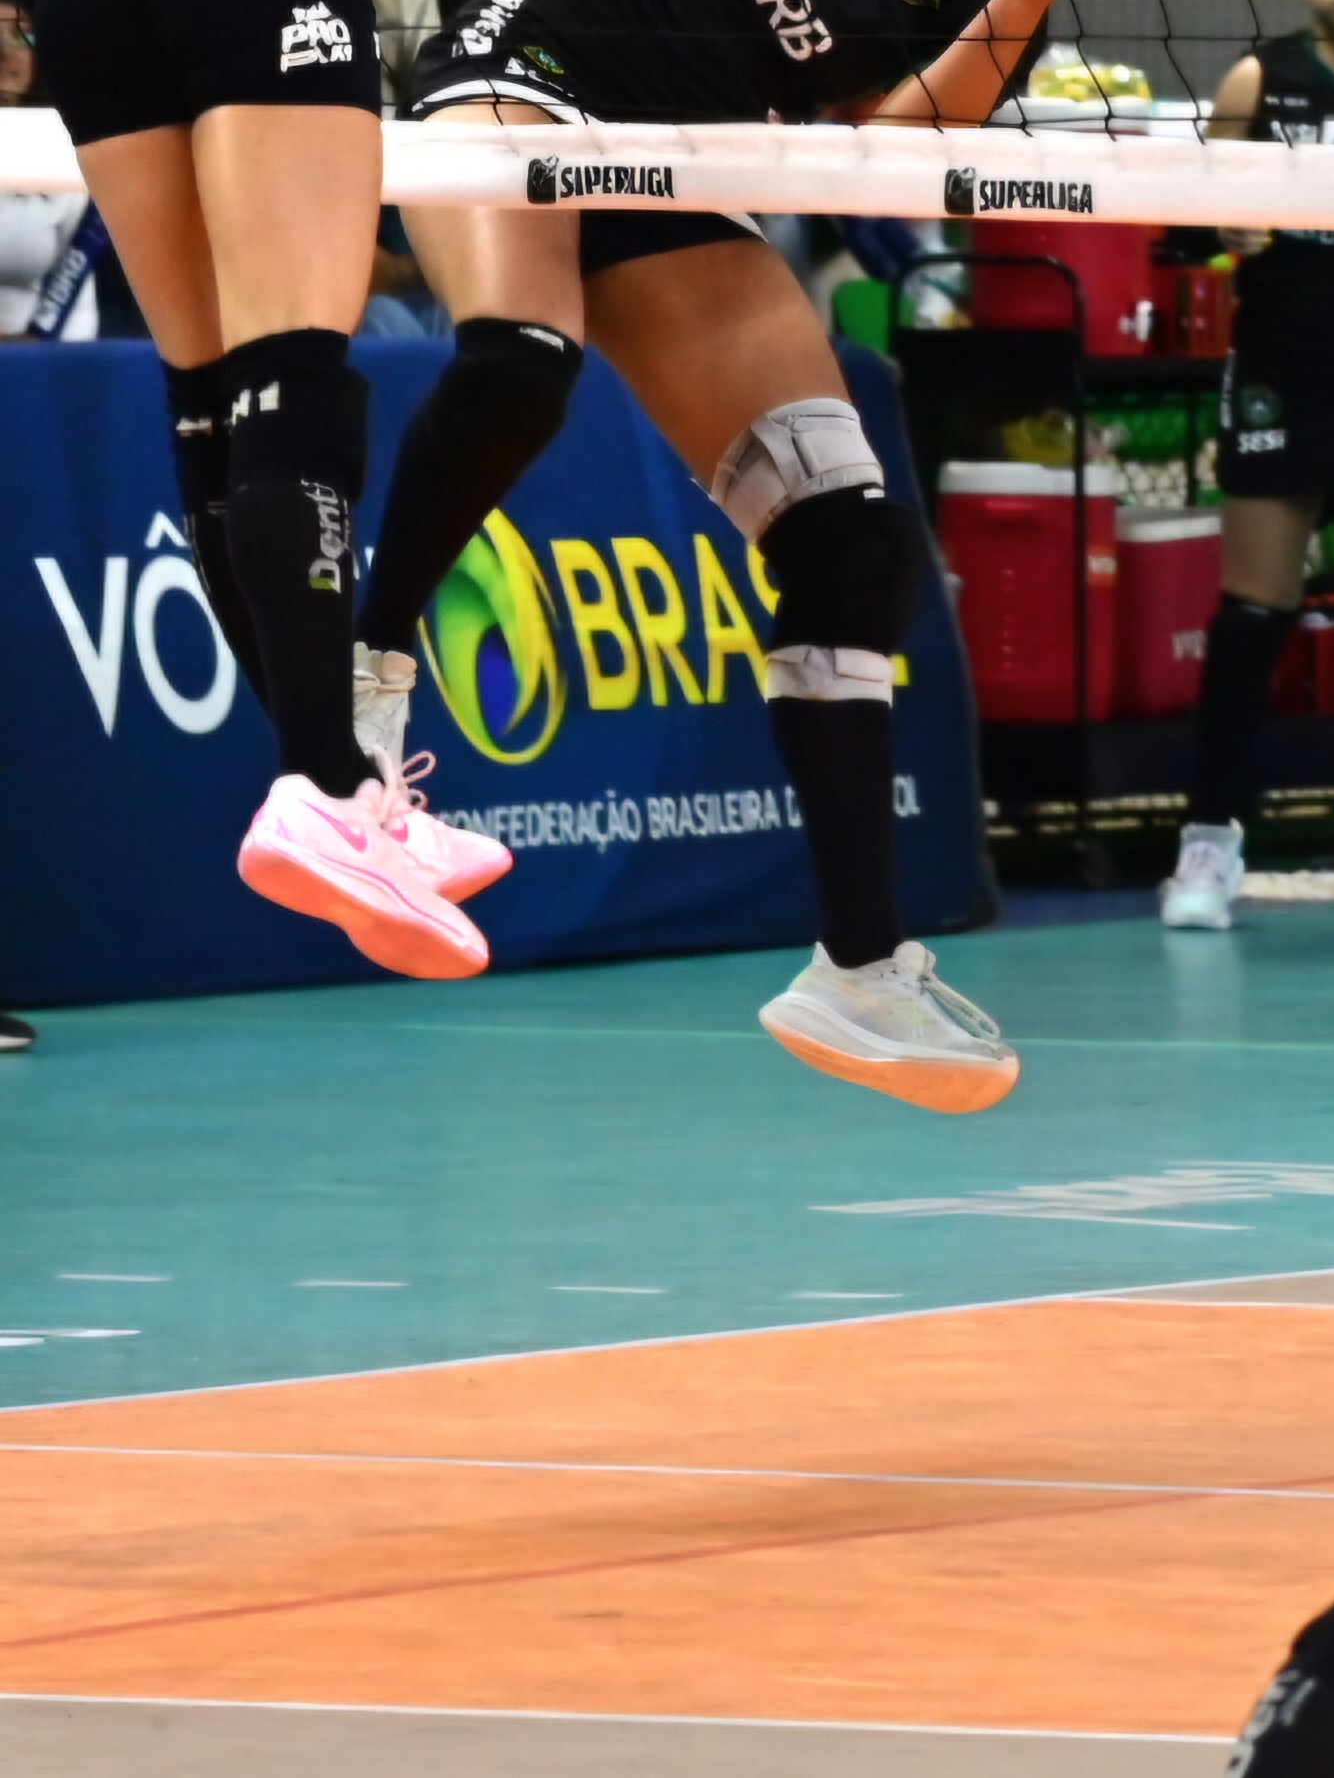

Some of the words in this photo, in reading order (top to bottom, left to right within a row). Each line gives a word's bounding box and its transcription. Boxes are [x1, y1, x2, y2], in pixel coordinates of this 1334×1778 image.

[560, 165, 676, 200] SUPERLIGA
[979, 180, 1094, 214] SUPERLIGA
[645, 788, 781, 841] BRASILEIRA
